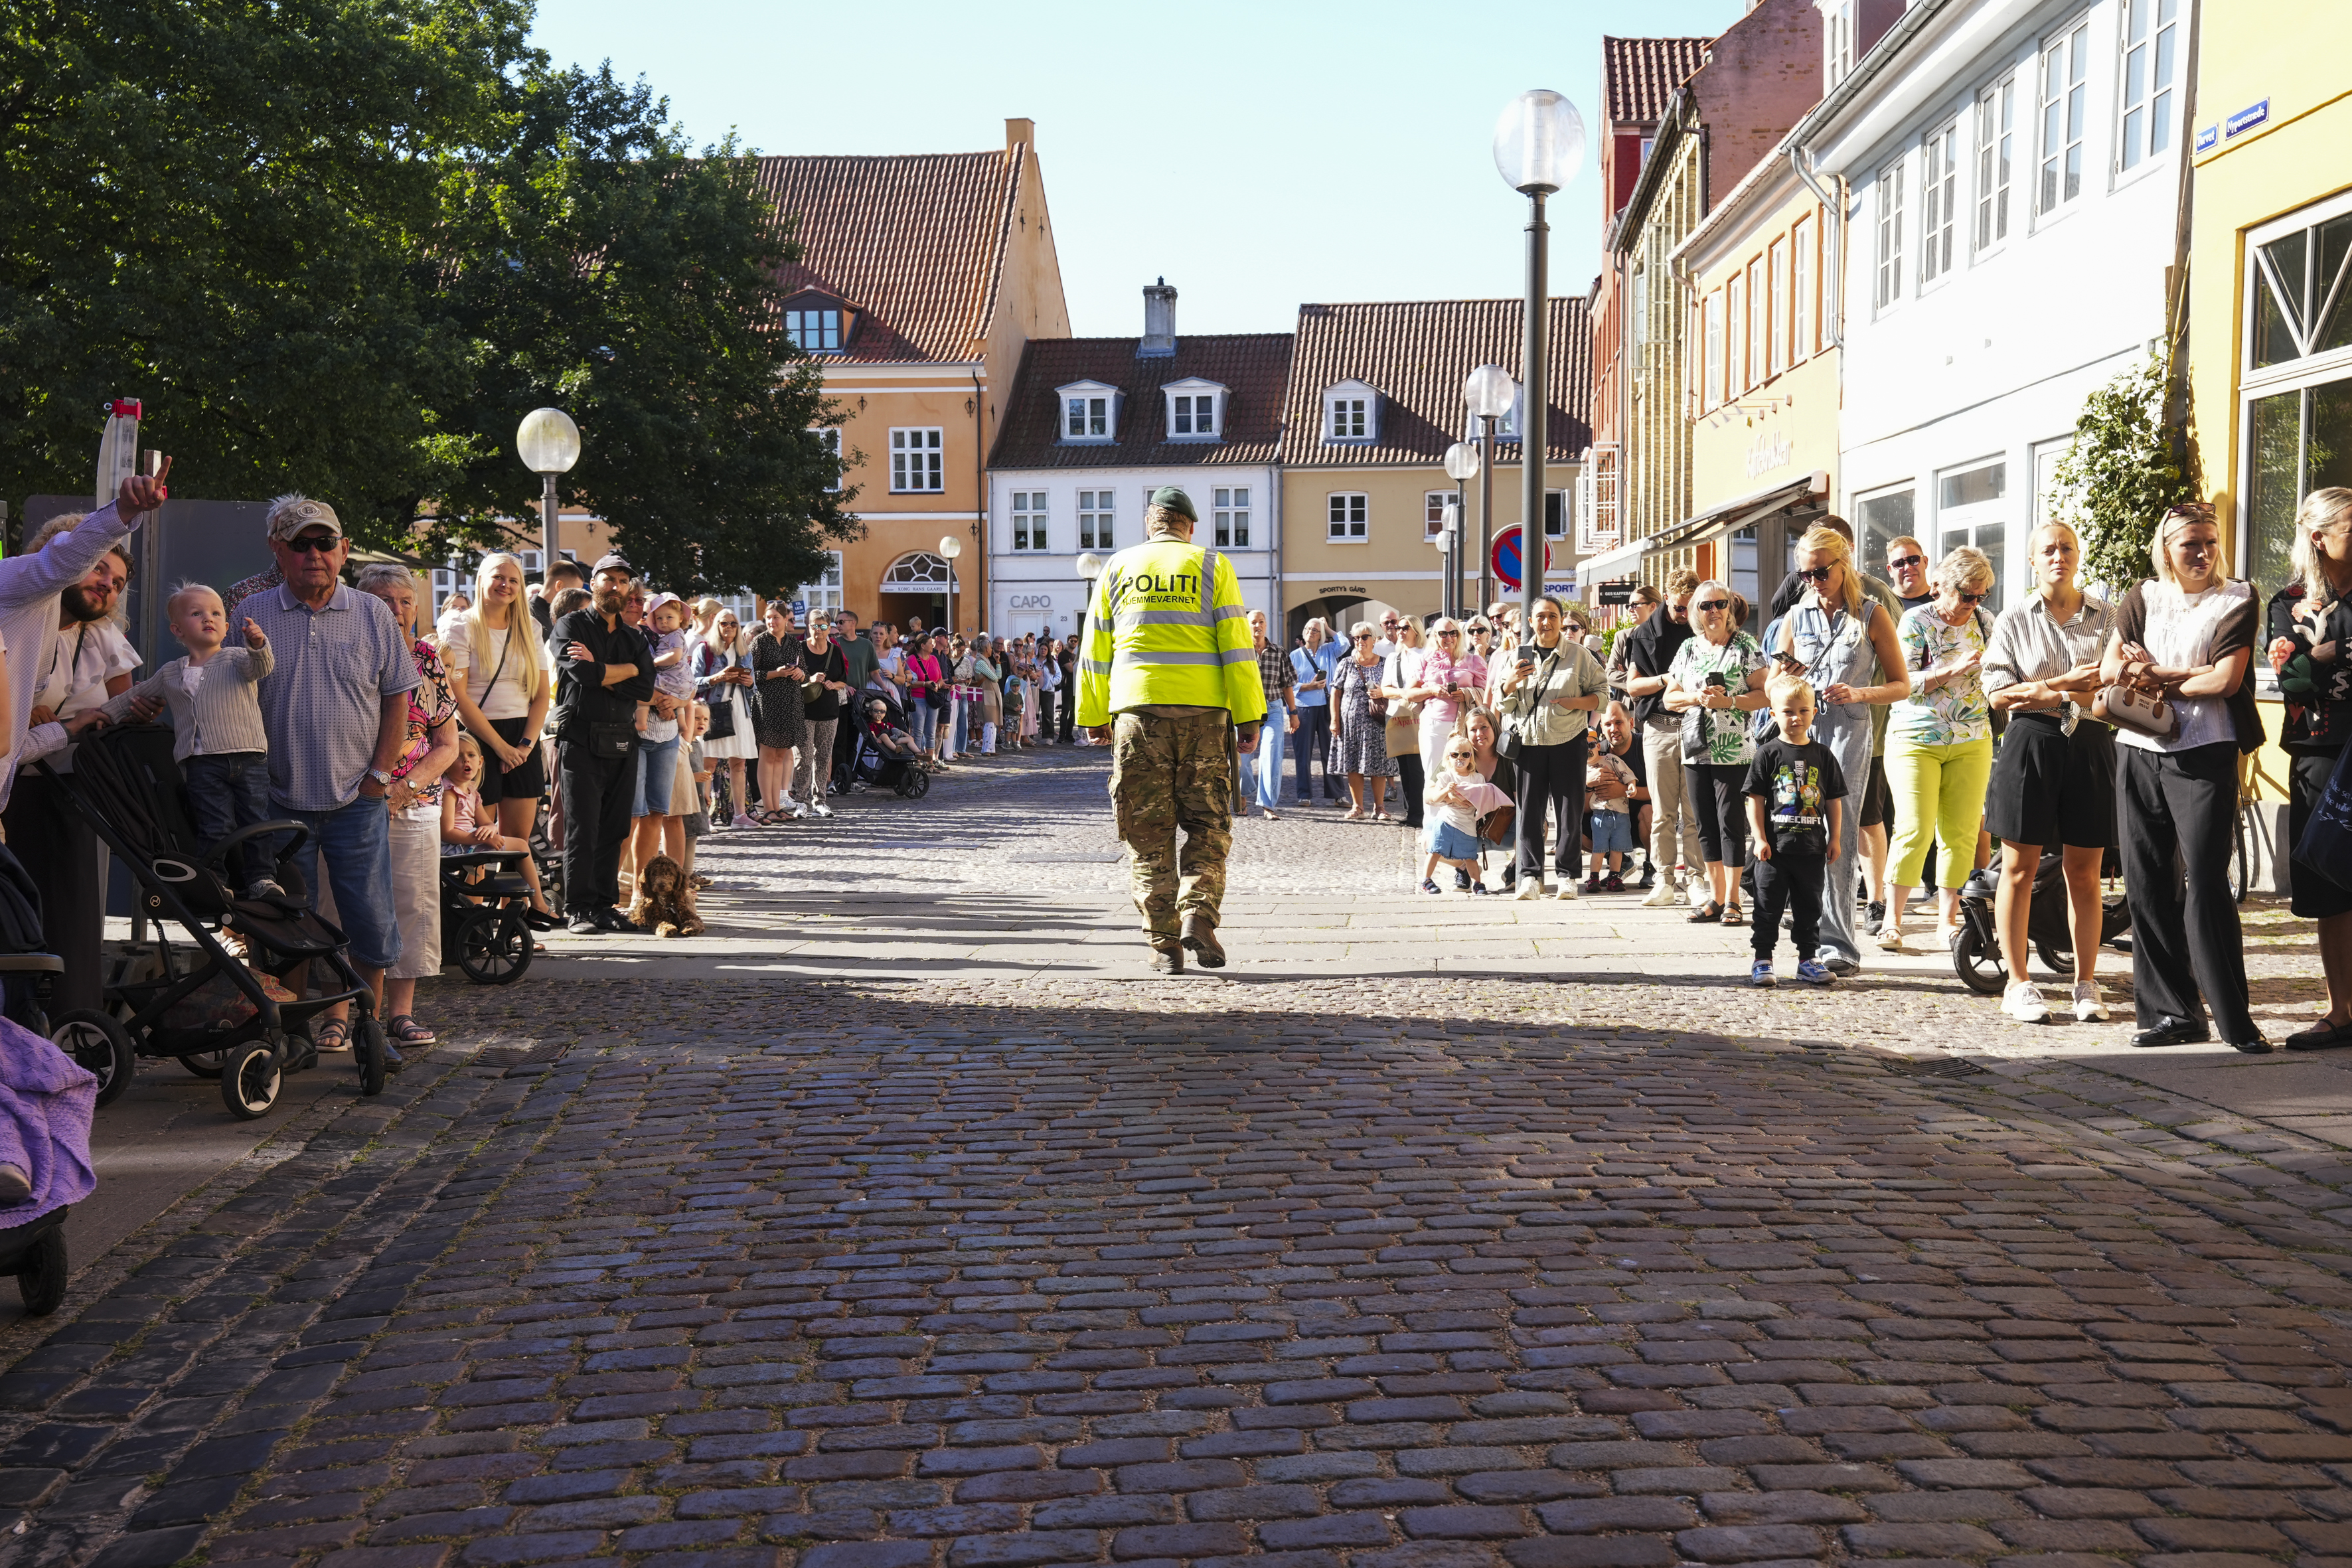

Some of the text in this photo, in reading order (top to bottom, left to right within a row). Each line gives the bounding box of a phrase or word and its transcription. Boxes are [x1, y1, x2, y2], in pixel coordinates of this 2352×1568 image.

[2227, 106, 2265, 133] Nyportstræde
[2197, 129, 2215, 147] Torvet
[1121, 574, 1197, 595] POLITI
[1010, 595, 1051, 608] CAPO
[1123, 595, 1196, 605] HJEMMEVÆRNET
[1770, 814, 1821, 824] MINECRAFT
